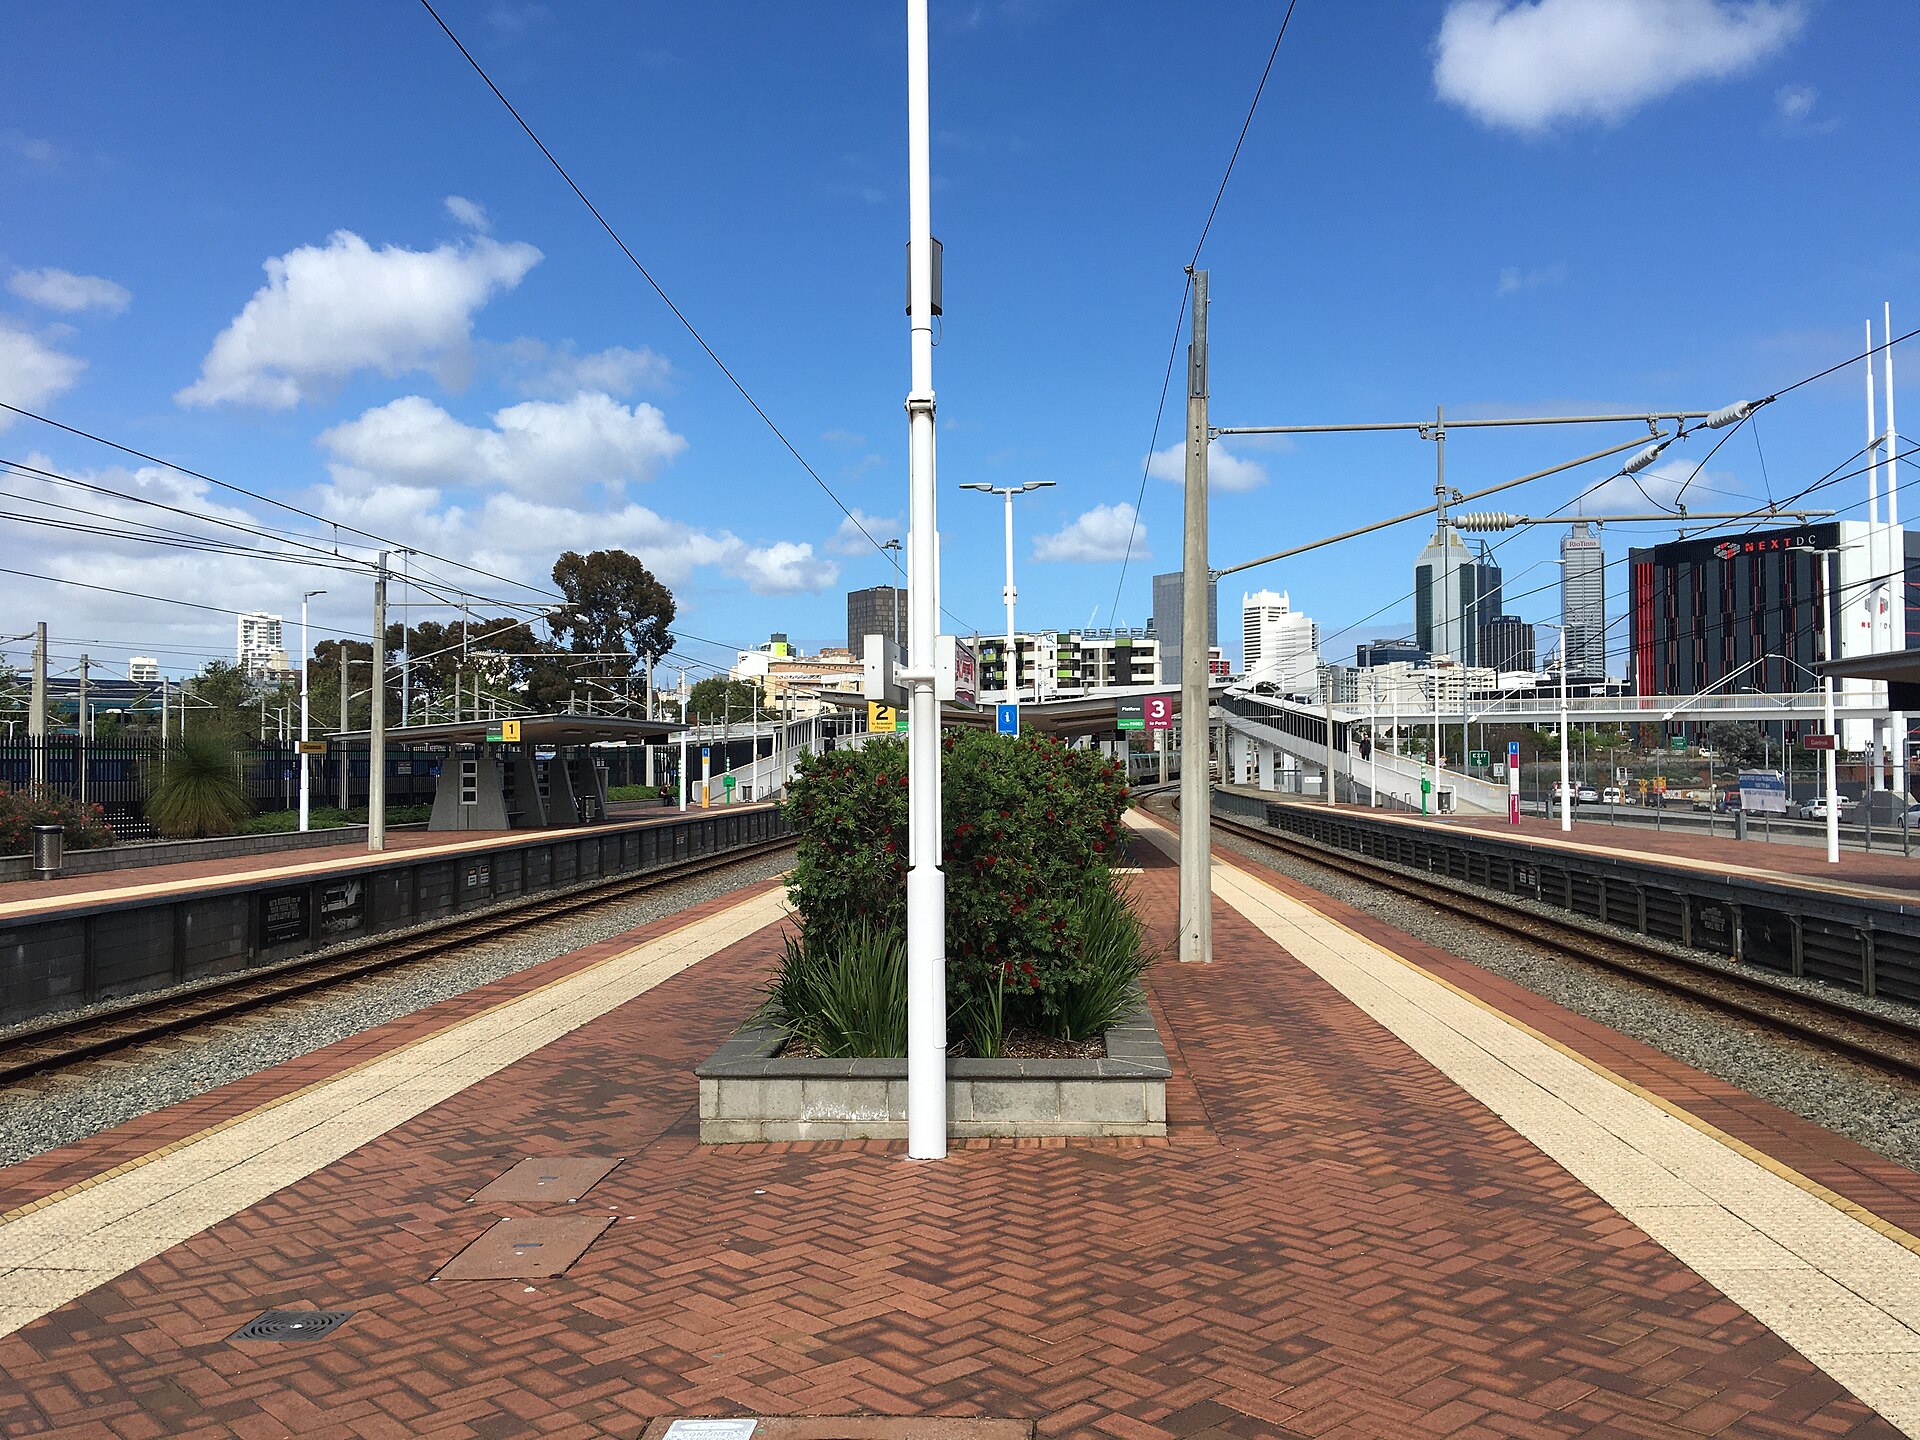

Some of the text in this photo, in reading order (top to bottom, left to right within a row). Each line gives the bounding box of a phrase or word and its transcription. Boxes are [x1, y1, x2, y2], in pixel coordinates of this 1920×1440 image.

[876, 704, 888, 720] 2
[1151, 700, 1165, 718] 3
[509, 724, 514, 734] 1
